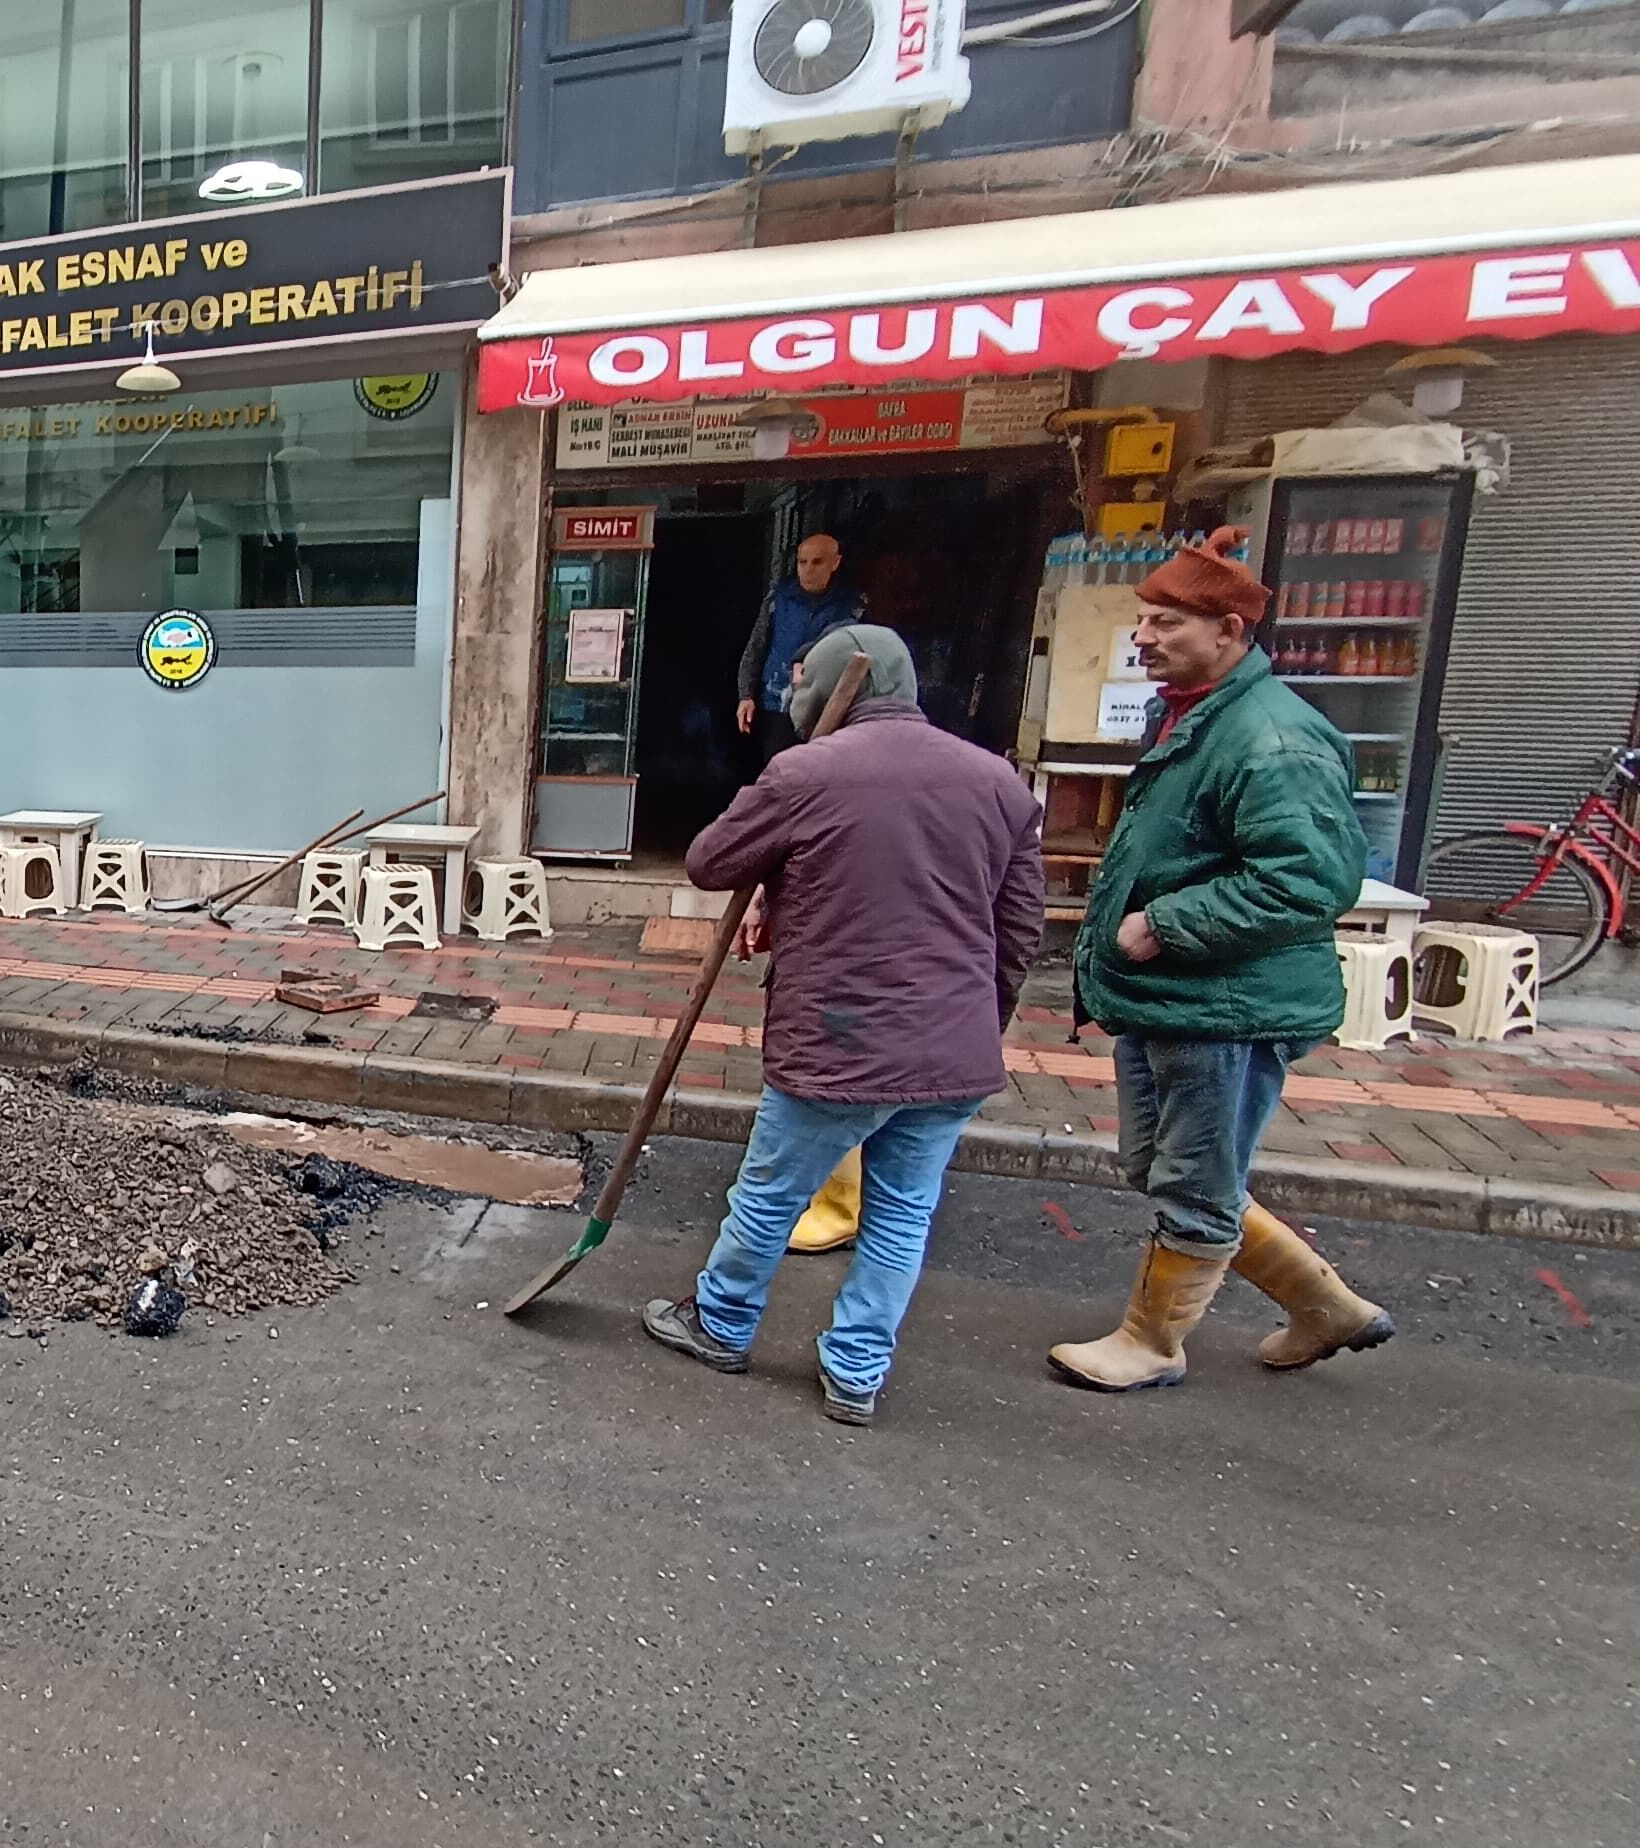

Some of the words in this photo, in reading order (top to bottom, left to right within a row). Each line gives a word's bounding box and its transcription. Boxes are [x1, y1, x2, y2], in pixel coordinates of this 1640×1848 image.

[57, 239, 188, 291] ESNAF
[201, 239, 248, 271] ve
[131, 259, 423, 340] KOOPERATİFİ
[588, 298, 1044, 387] OLGUN
[1096, 266, 1416, 360] ÇAY
[94, 400, 279, 434] KOOPERATİFİ
[573, 517, 633, 537] SİMİT
